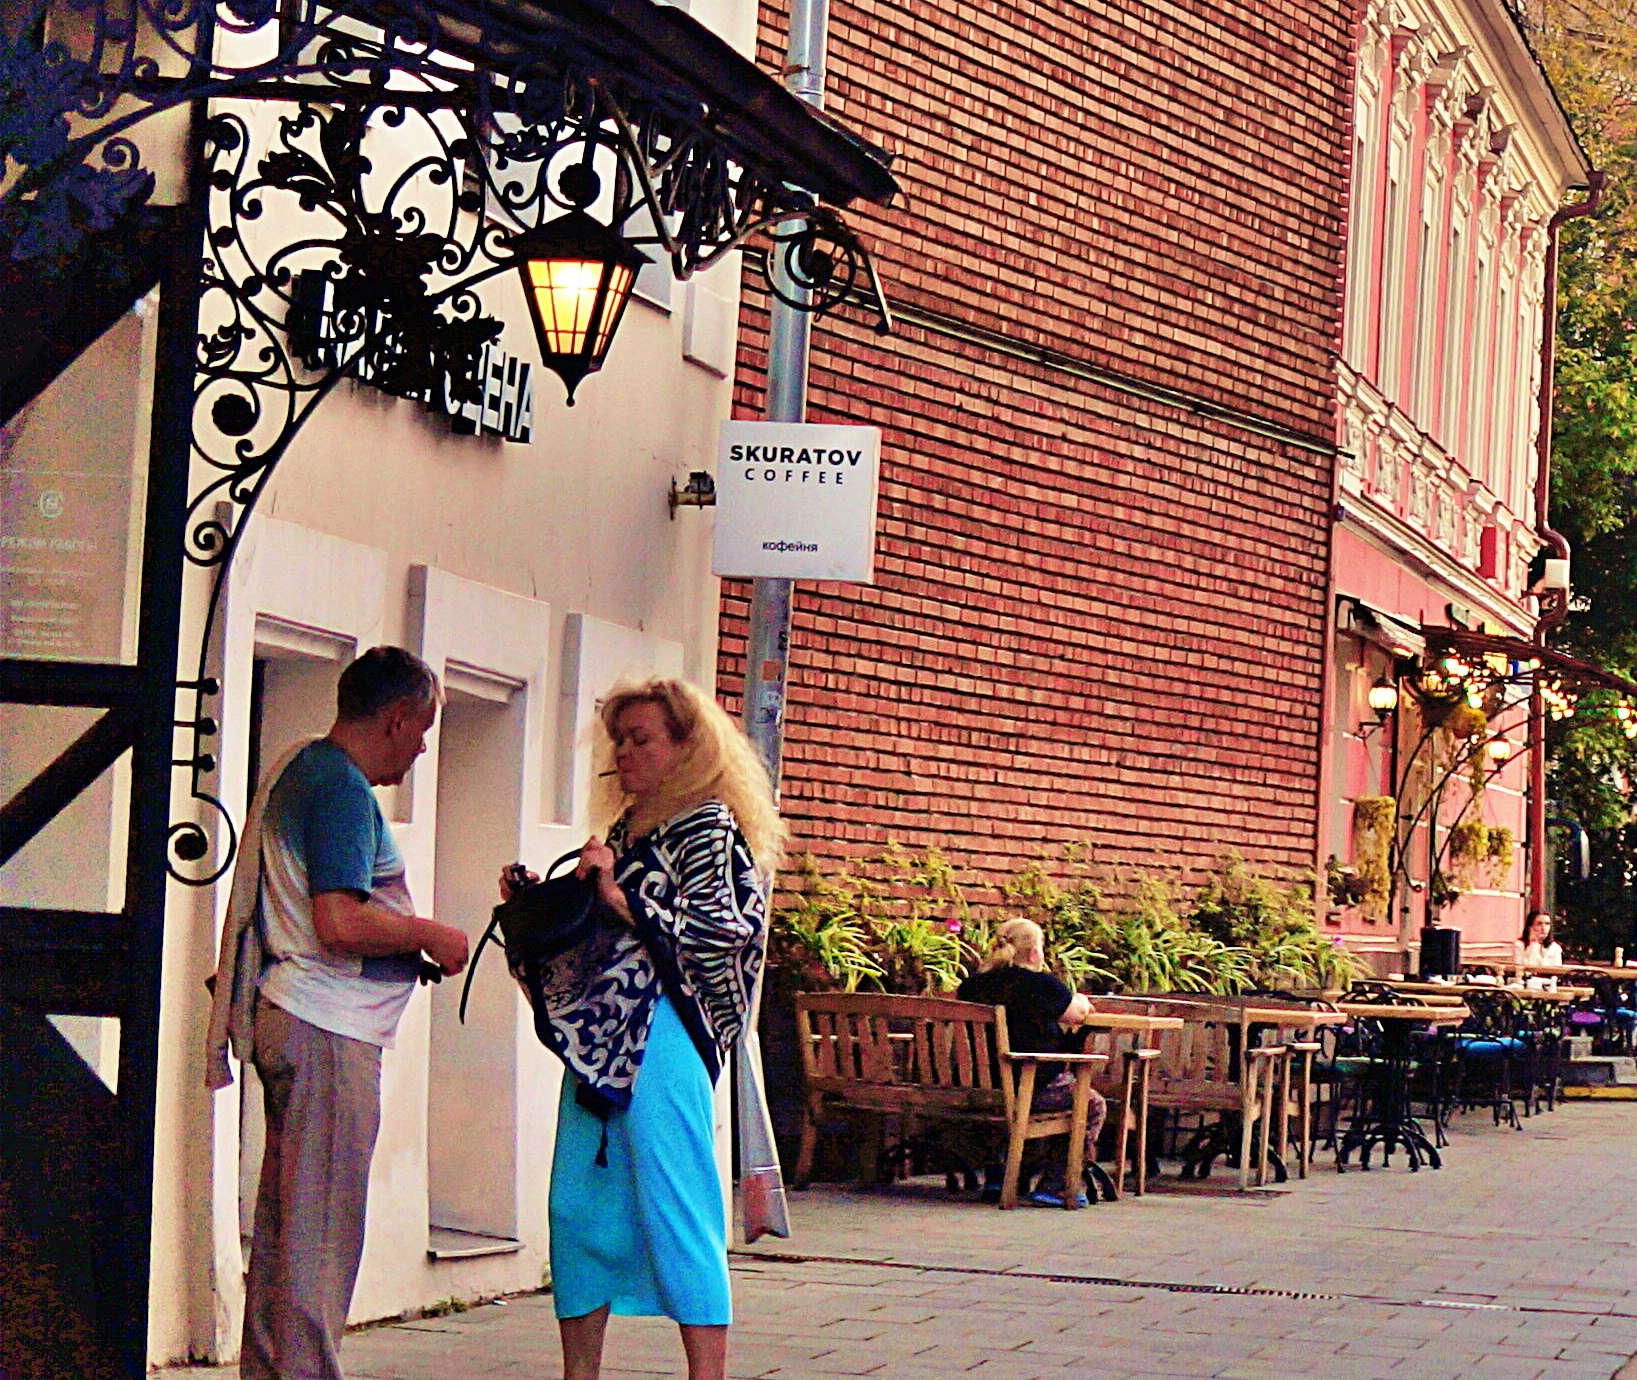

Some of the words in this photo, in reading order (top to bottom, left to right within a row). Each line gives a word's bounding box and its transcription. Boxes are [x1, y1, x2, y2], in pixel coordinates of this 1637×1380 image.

[730, 445, 862, 466] SKURATOV
[745, 468, 843, 484] COFFEE
[762, 540, 818, 553] кофейня
